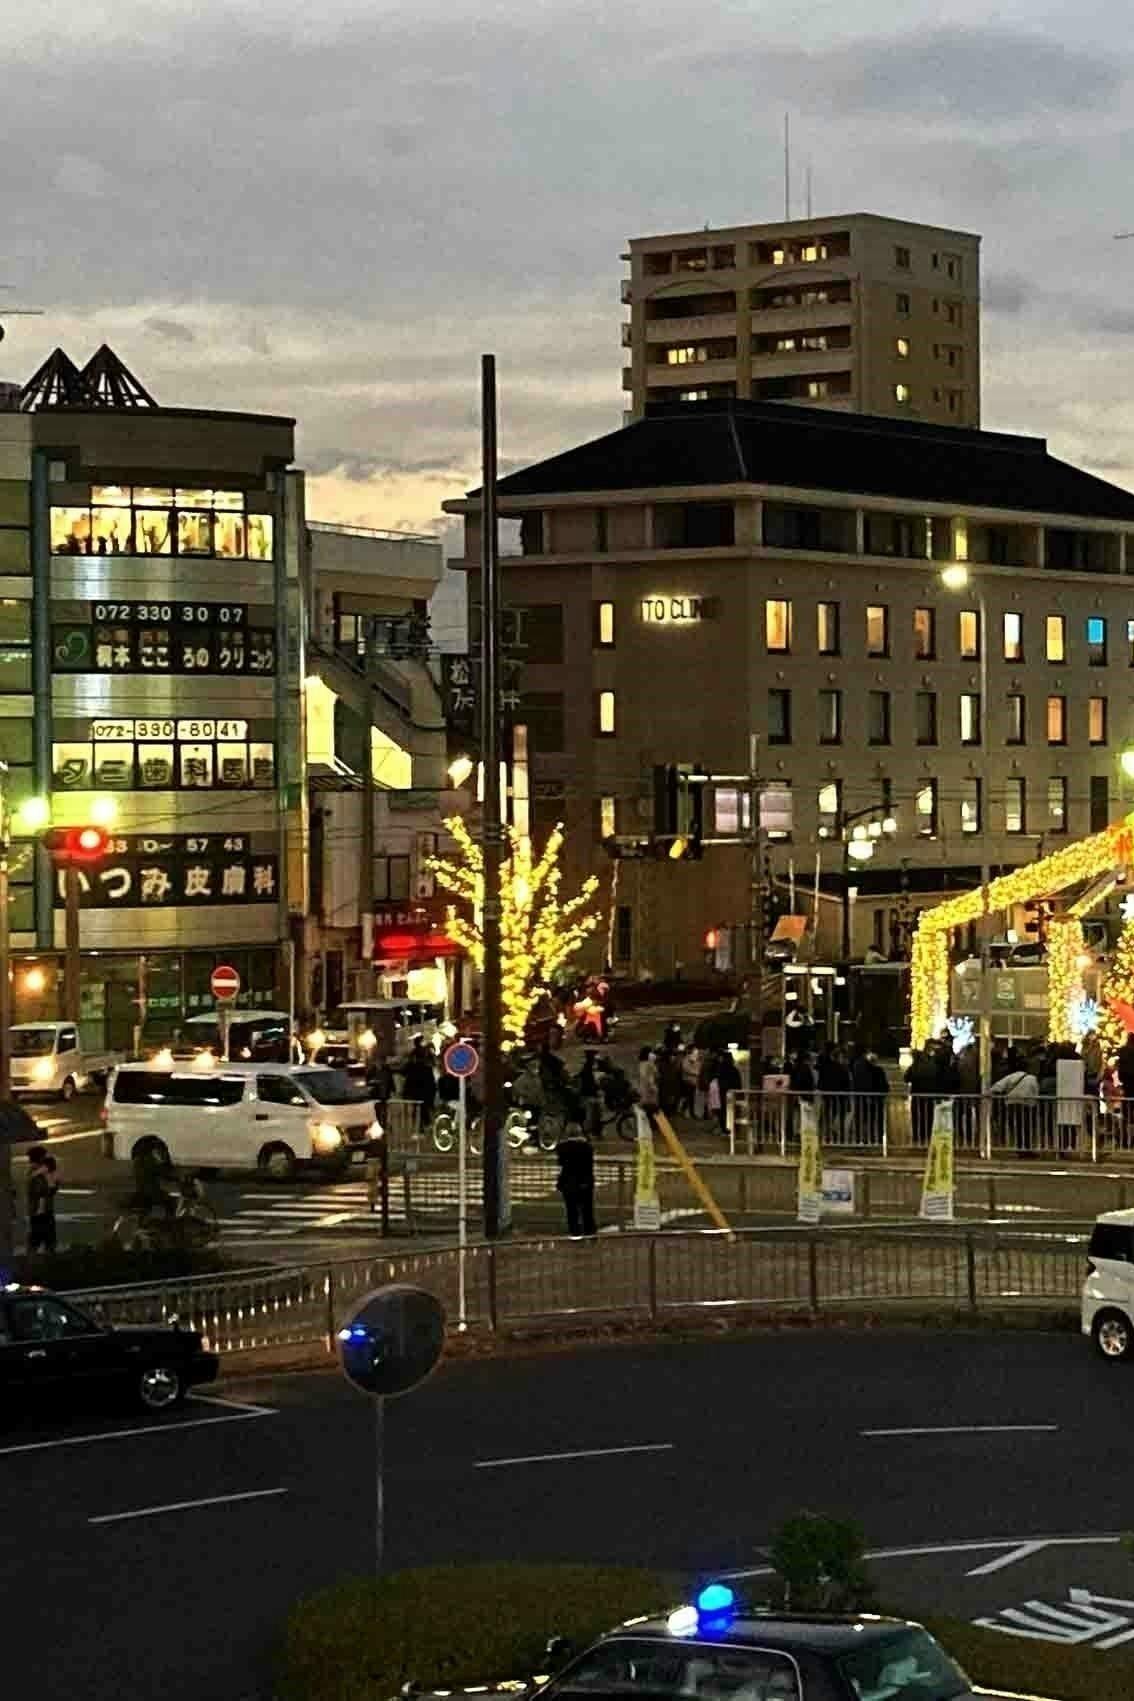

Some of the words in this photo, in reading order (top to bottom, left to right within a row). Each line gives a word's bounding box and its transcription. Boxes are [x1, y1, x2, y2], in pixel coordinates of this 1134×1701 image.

[95, 604, 131, 620] 072
[137, 605, 172, 621] 330
[183, 606, 209, 622] 30
